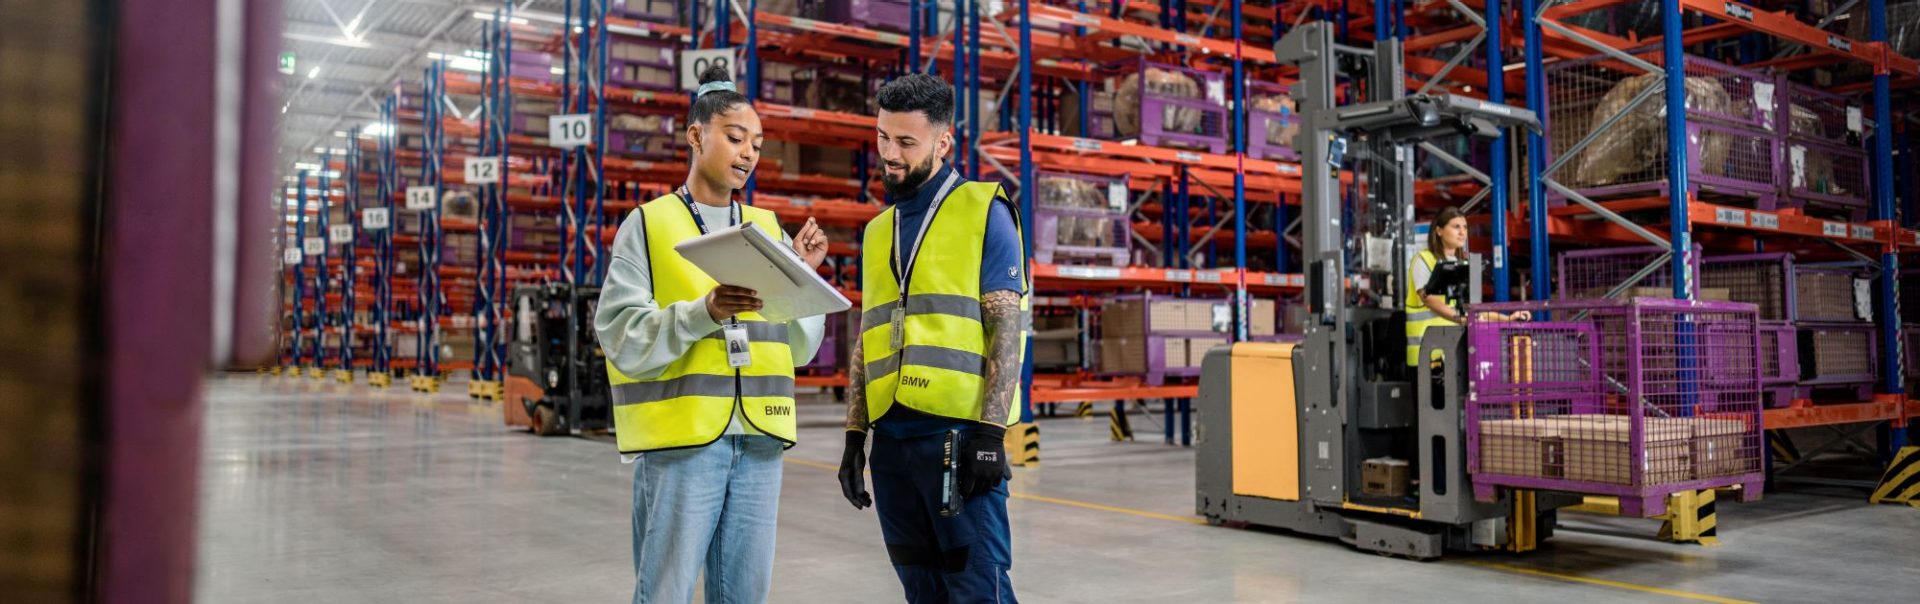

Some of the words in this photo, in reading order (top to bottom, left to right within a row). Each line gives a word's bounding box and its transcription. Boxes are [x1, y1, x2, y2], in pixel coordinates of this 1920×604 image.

[560, 120, 586, 140] 10
[472, 162, 493, 178] 12
[412, 191, 430, 204] 14
[368, 212, 384, 224] 16
[901, 375, 930, 388] BMW
[765, 405, 791, 416] BMW
